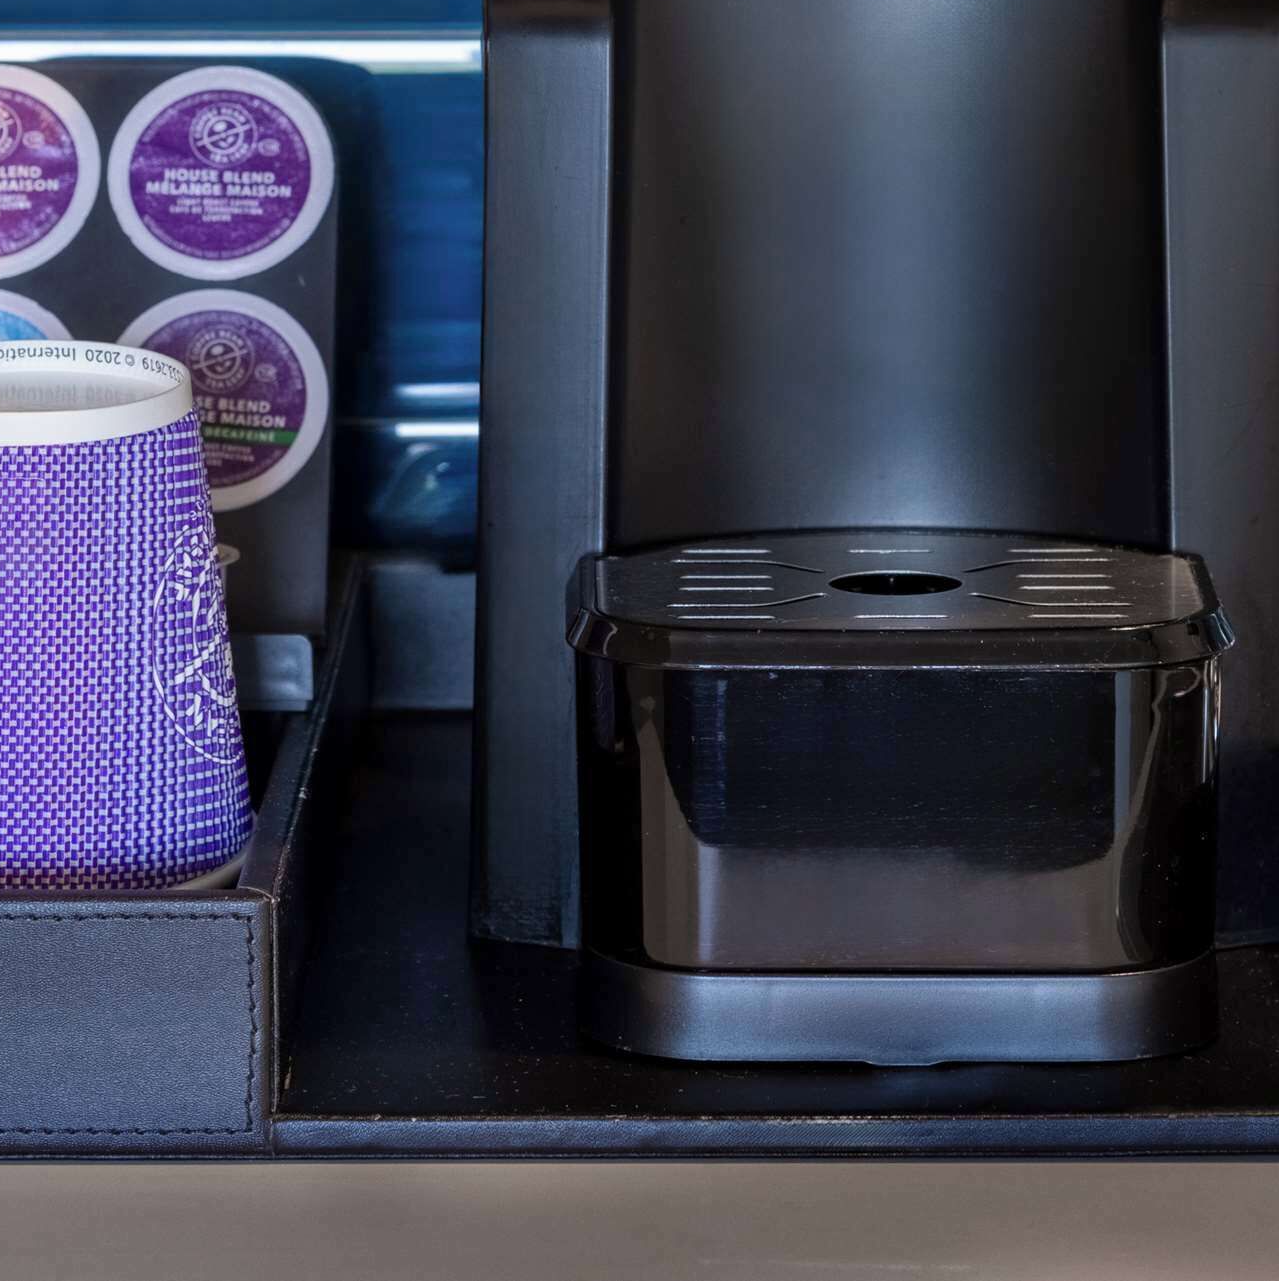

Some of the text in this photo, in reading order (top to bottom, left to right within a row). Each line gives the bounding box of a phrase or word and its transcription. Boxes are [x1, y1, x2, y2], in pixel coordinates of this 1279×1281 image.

[163, 168, 276, 185] HOUSE BLEND
[225, 184, 293, 198] MAISON
[84, 348, 121, 366] 2020
[217, 398, 271, 414] BLEND
[220, 413, 287, 429] MAISON
